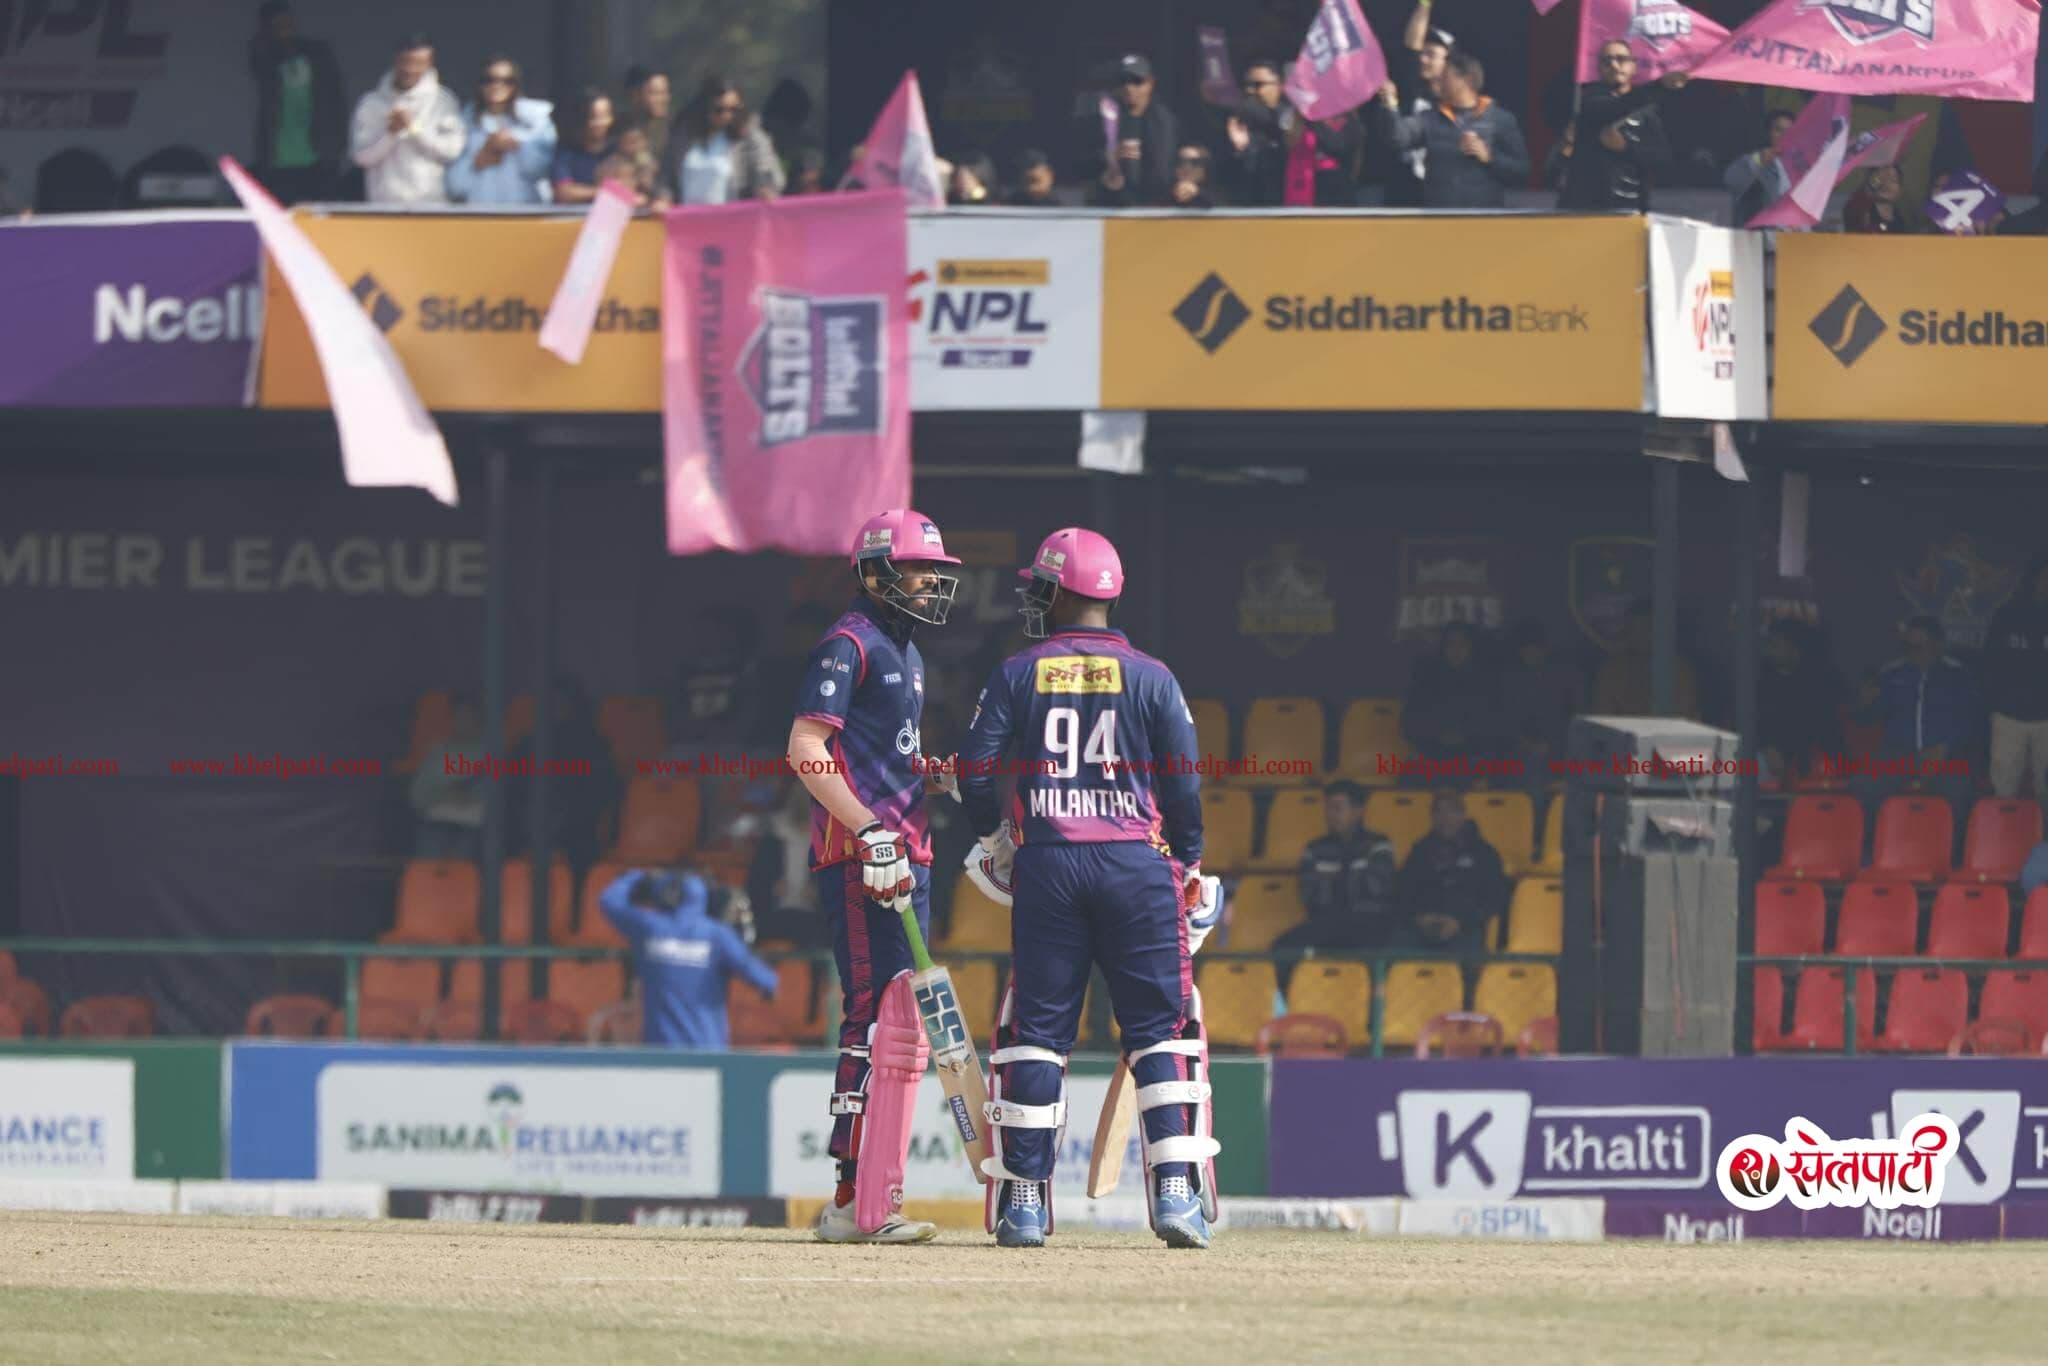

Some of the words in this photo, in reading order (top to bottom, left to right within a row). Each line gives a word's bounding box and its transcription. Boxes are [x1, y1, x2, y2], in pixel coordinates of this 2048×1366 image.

[95, 284, 261, 343] Ncell
[418, 296, 659, 333] Siddhtha
[929, 291, 1048, 334] NPL
[1264, 296, 1513, 332] Siddhartha
[1516, 303, 1590, 333] Bank
[185, 537, 487, 596] LEAGUE
[1044, 707, 1120, 780] 94
[0, 1115, 104, 1147] ANCE
[347, 1123, 493, 1153] SANIMA
[516, 1125, 690, 1157] RELIANCE
[1542, 1123, 1686, 1172] khalti
[1480, 1208, 1548, 1234] SPIL
[1665, 1213, 1744, 1243] Ncell
[1863, 1205, 1941, 1240] Ncell
